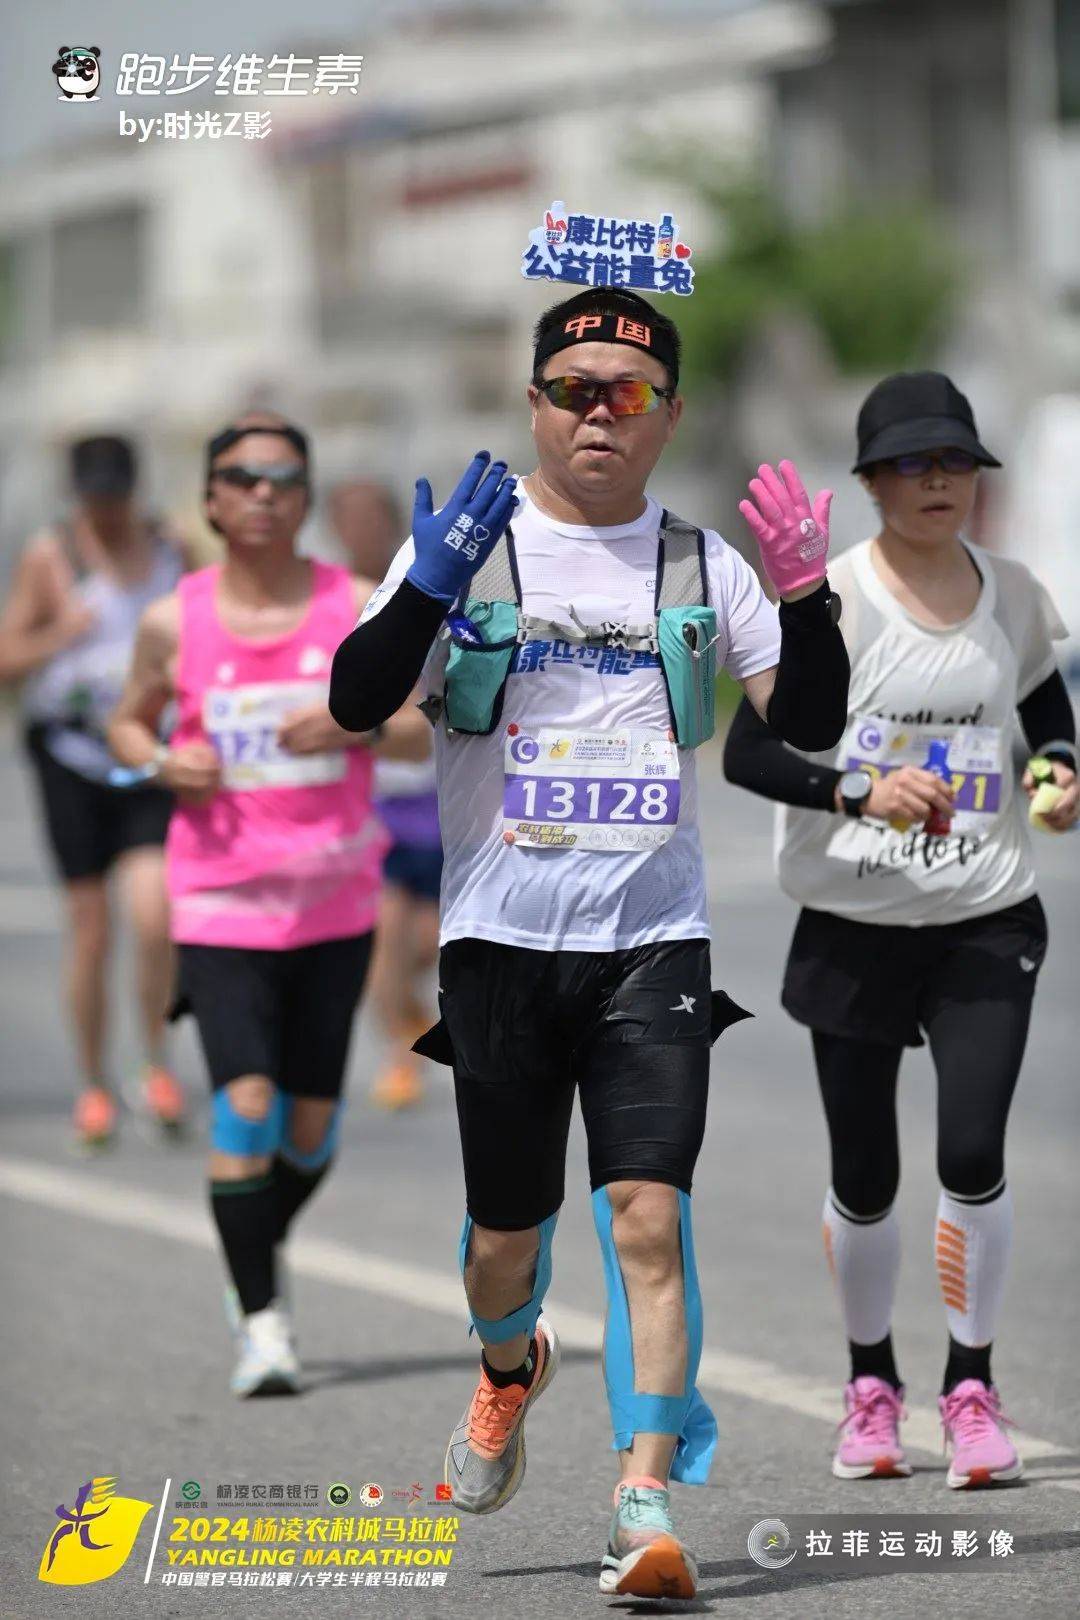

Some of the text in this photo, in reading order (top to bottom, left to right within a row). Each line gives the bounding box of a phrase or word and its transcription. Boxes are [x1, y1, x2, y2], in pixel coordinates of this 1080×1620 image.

[566, 216, 655, 253] 康比特
[524, 245, 692, 294] 公益能量兔
[564, 315, 652, 347] 中国
[444, 526, 480, 561] 西马
[522, 780, 668, 821] 13128
